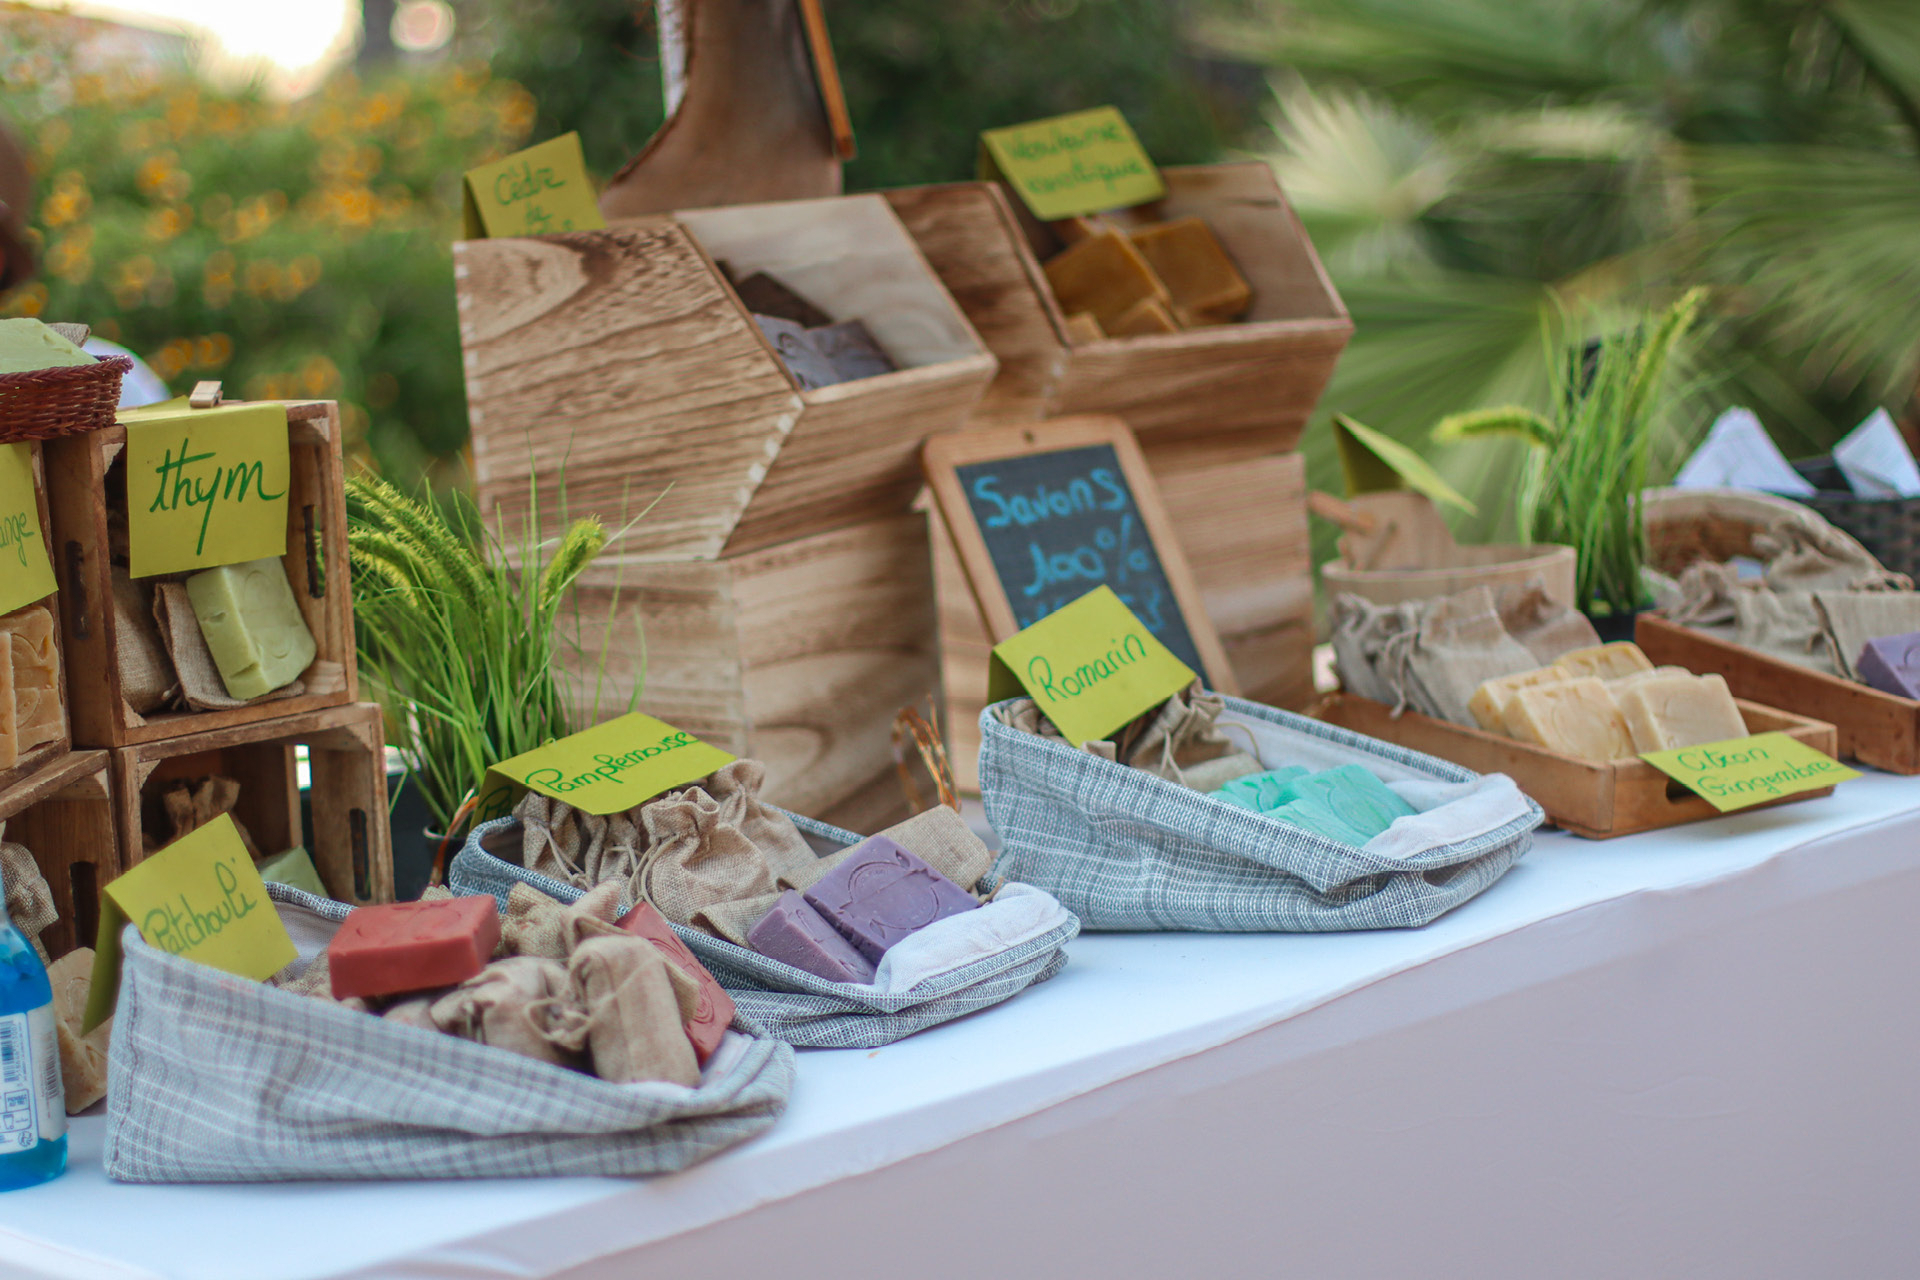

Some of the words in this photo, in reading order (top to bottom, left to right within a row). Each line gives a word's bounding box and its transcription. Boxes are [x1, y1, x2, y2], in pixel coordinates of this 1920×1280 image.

[149, 437, 287, 556] thym
[973, 468, 1127, 527] Savons
[1023, 512, 1150, 597] 100%
[1028, 634, 1147, 702] Romarin
[1677, 747, 1770, 772] Citron
[1697, 760, 1844, 797] Gingembre
[143, 856, 258, 956] Patchouli
